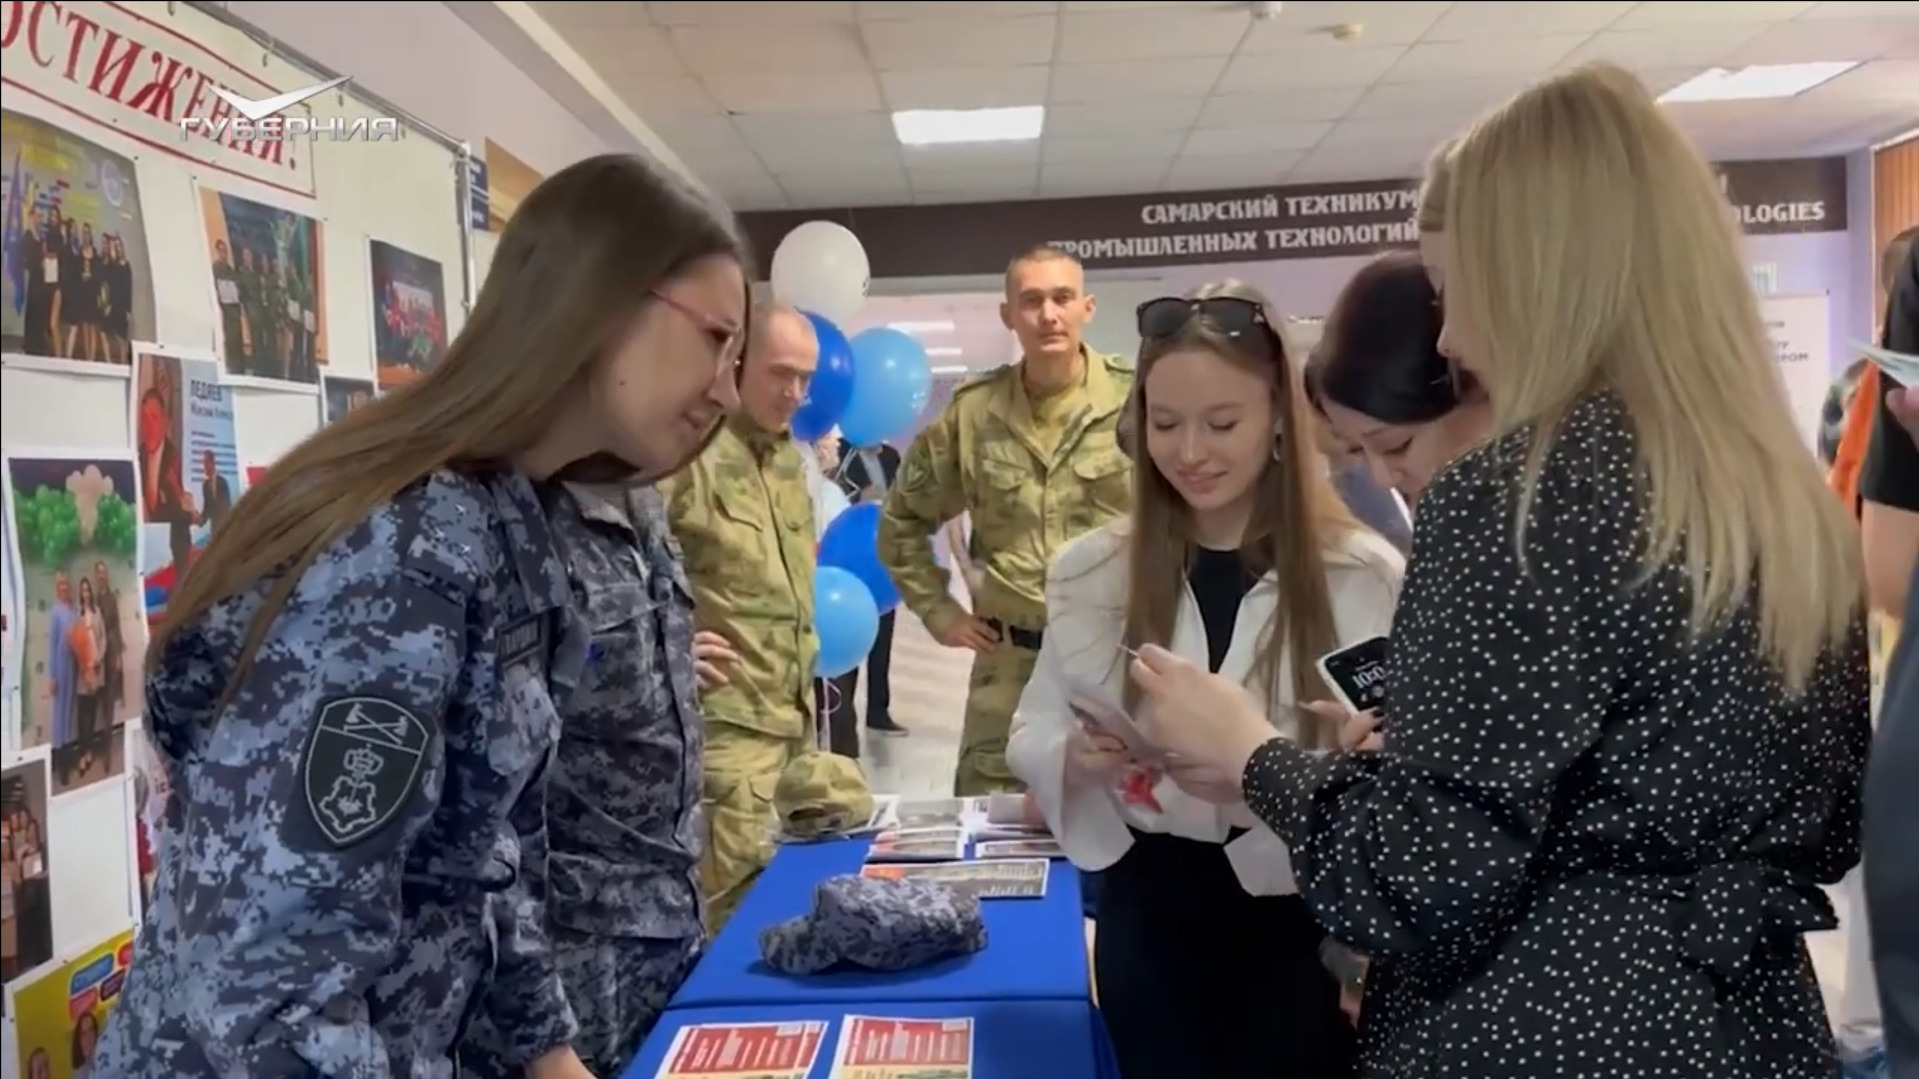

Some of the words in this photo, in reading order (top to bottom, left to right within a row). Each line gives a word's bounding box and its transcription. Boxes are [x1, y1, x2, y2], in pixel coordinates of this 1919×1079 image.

[1141, 194, 1279, 225] САМАРСКИЙ
[1285, 189, 1417, 217] ТЕХНИКУМ
[1264, 217, 1418, 250] ТЕХНОЛОГИЙ
